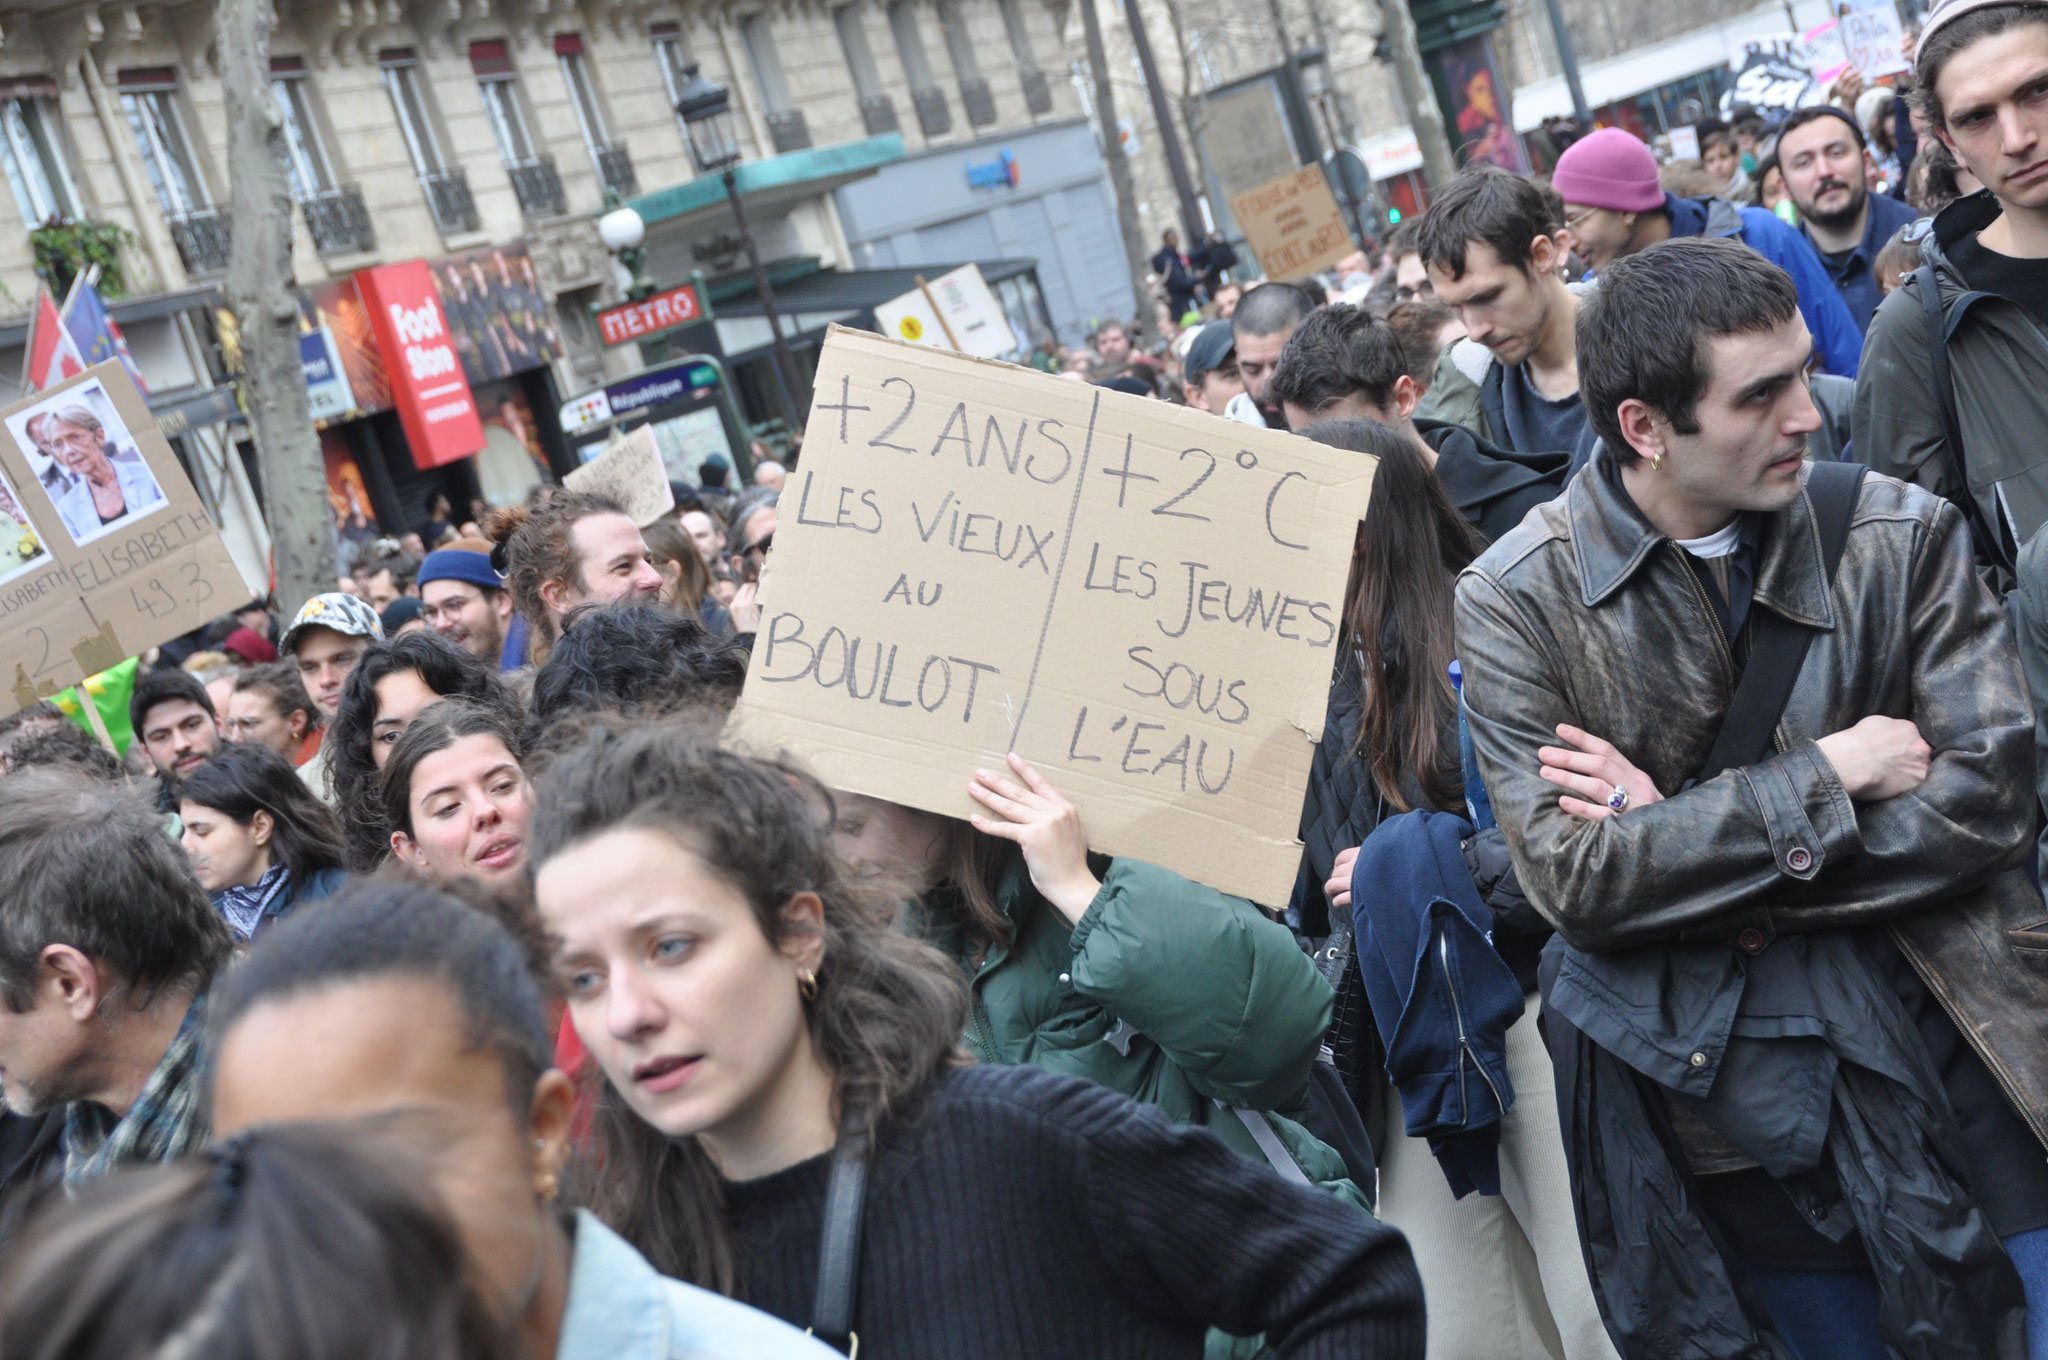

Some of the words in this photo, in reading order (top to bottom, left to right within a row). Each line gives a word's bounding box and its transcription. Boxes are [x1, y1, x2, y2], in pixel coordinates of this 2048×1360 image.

[389, 296, 444, 345] Foot
[603, 292, 693, 341] METRO
[405, 345, 456, 381] Store
[610, 378, 683, 411] République
[931, 402, 1072, 484] ANS
[797, 471, 882, 534] LES
[70, 512, 210, 593] ELISABETH
[130, 561, 214, 619] 49.3
[883, 574, 942, 606] AU
[1085, 543, 1157, 599] LES
[1156, 560, 1336, 648] JEUNES
[26, 626, 73, 678] 2
[760, 612, 1000, 722] BOULOT
[1123, 646, 1249, 724] SOUS
[1070, 707, 1234, 795] L'EAU
